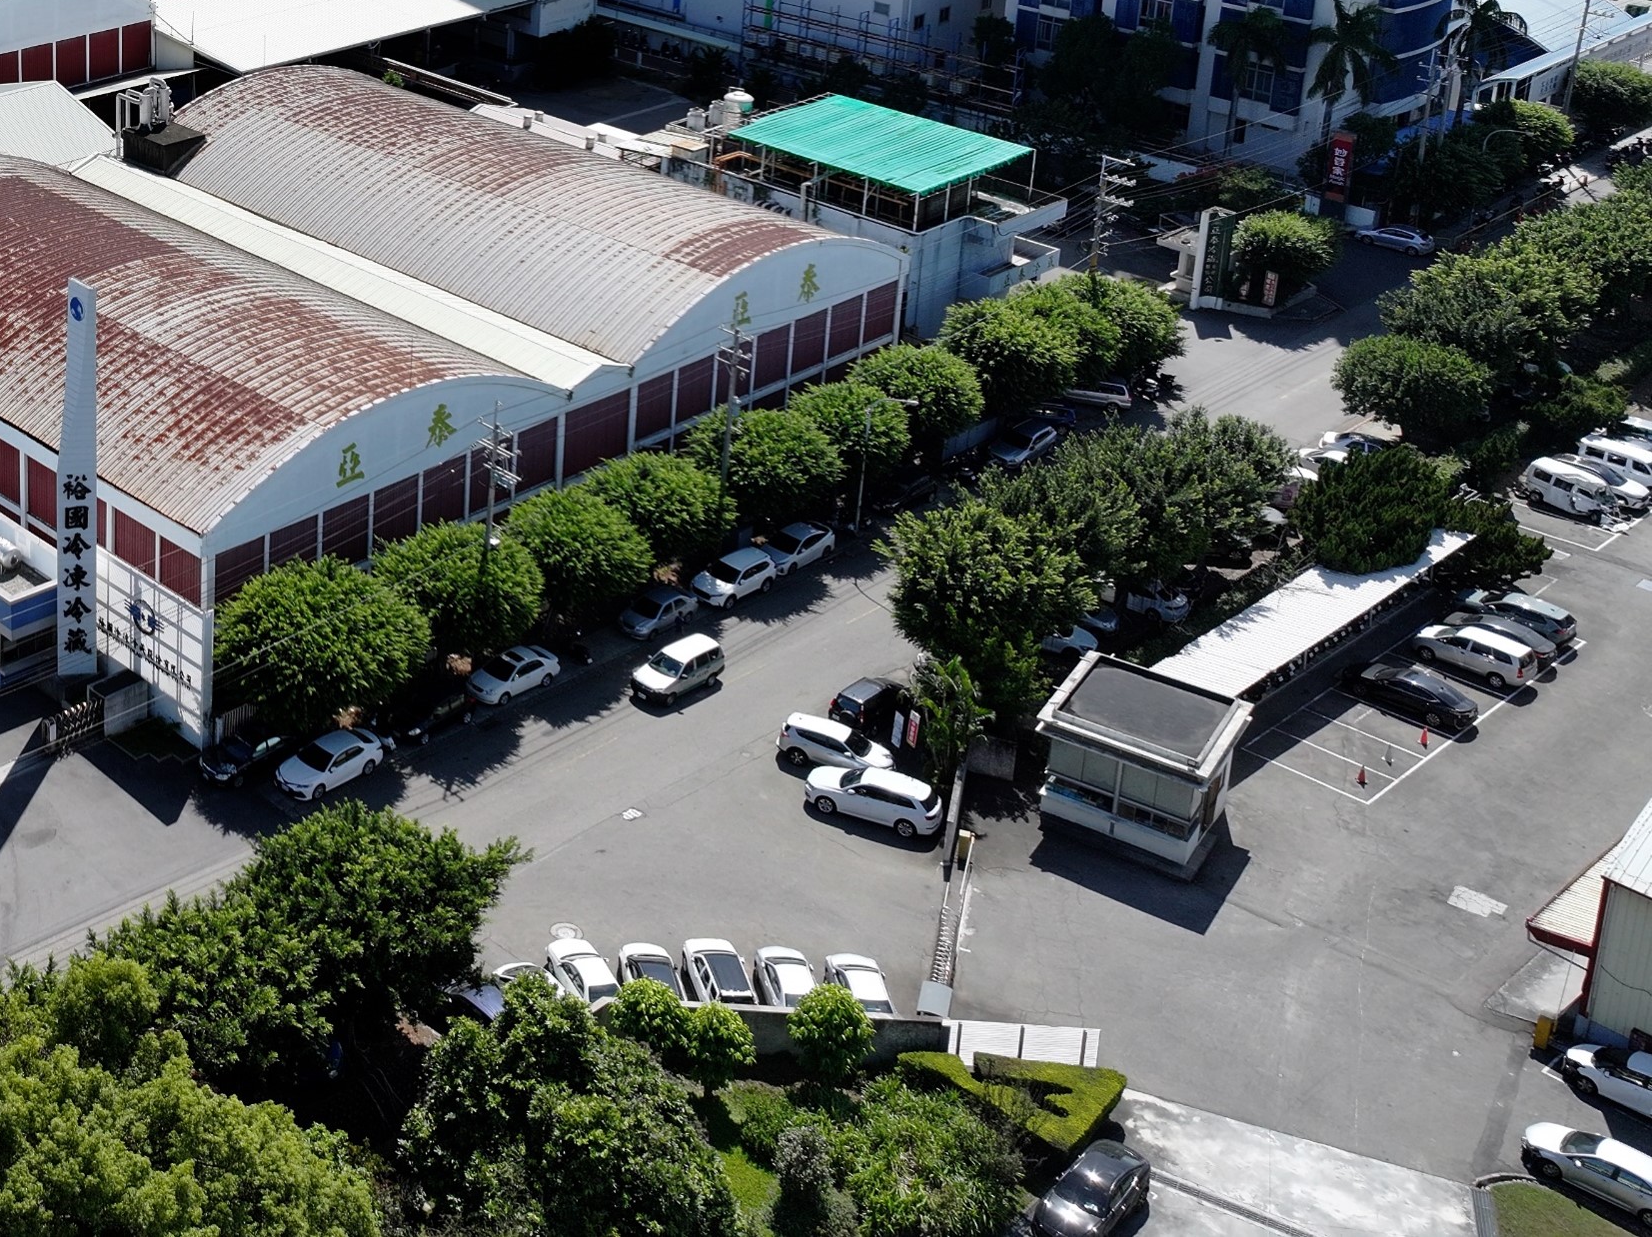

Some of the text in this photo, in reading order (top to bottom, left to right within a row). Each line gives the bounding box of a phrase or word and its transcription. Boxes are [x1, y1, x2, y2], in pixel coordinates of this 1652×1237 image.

[62, 474, 92, 656] 裕國冷凍冷藏
